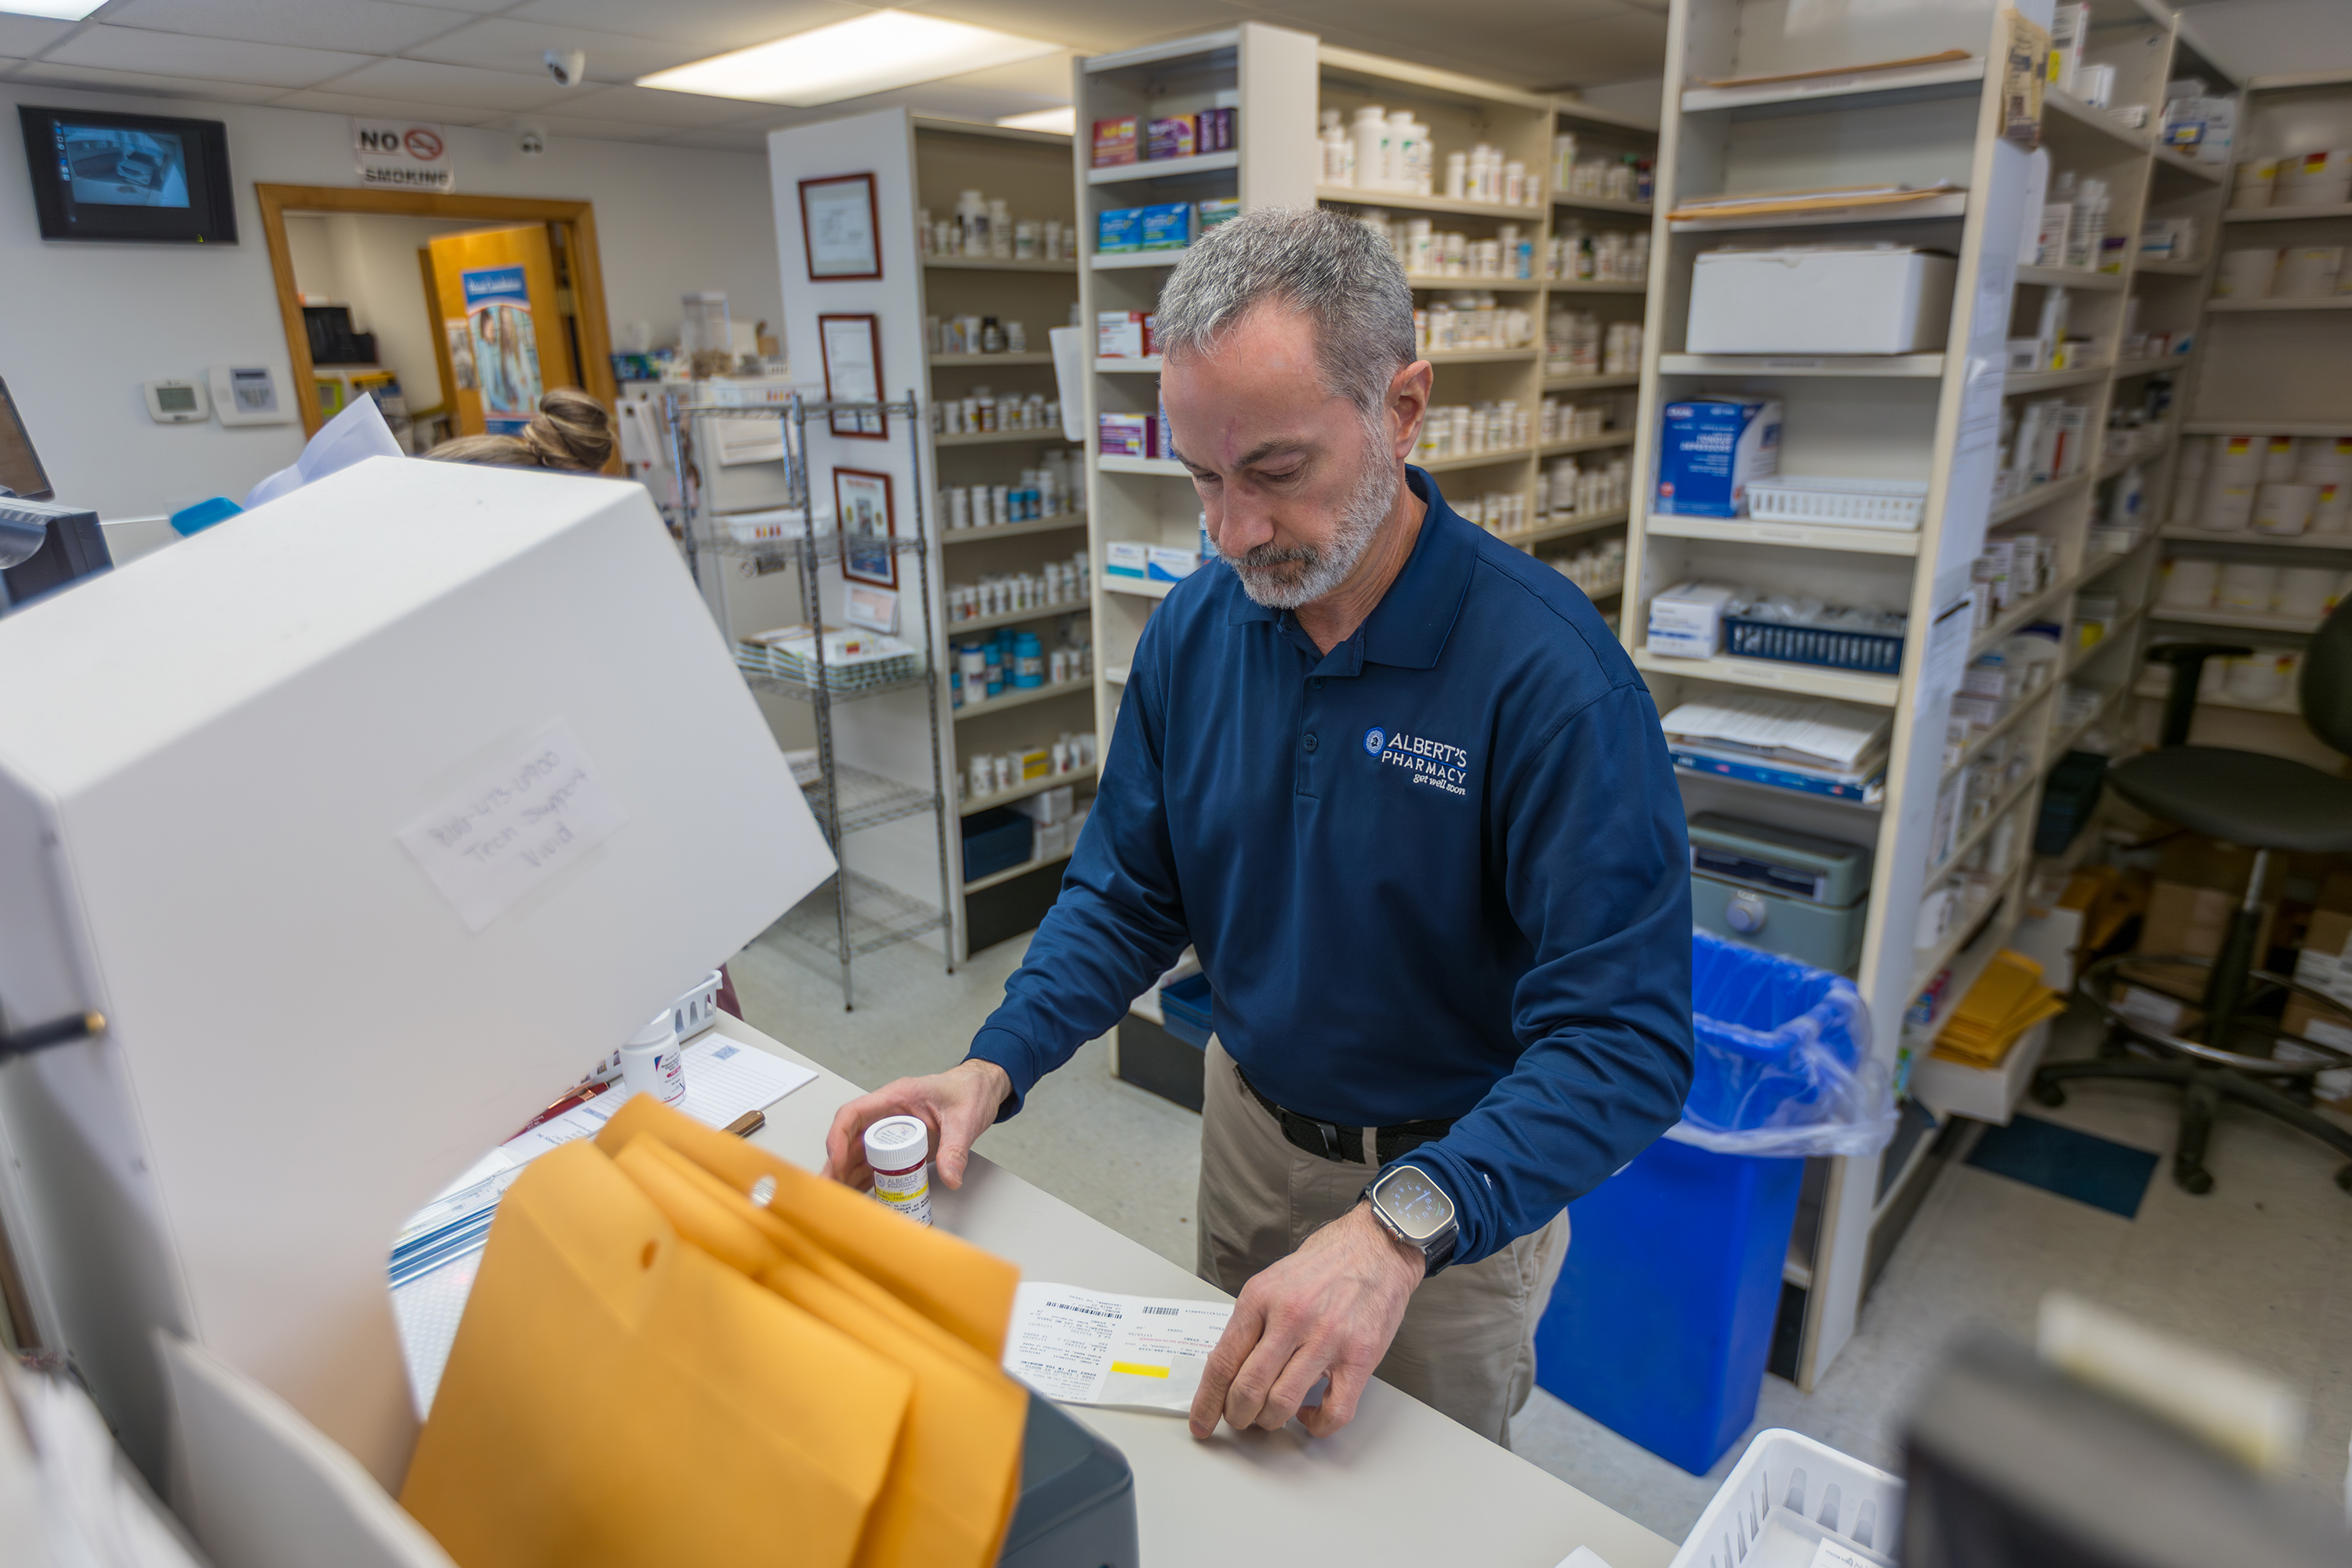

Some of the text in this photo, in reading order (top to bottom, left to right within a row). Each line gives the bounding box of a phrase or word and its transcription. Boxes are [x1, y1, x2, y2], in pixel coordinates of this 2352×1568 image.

[361, 130, 399, 150] NO
[365, 168, 448, 186] SMOKING
[1388, 733, 1466, 768] ALBERT'S
[1382, 751, 1466, 784] PHARMACY
[1413, 774, 1466, 795] get well soon
